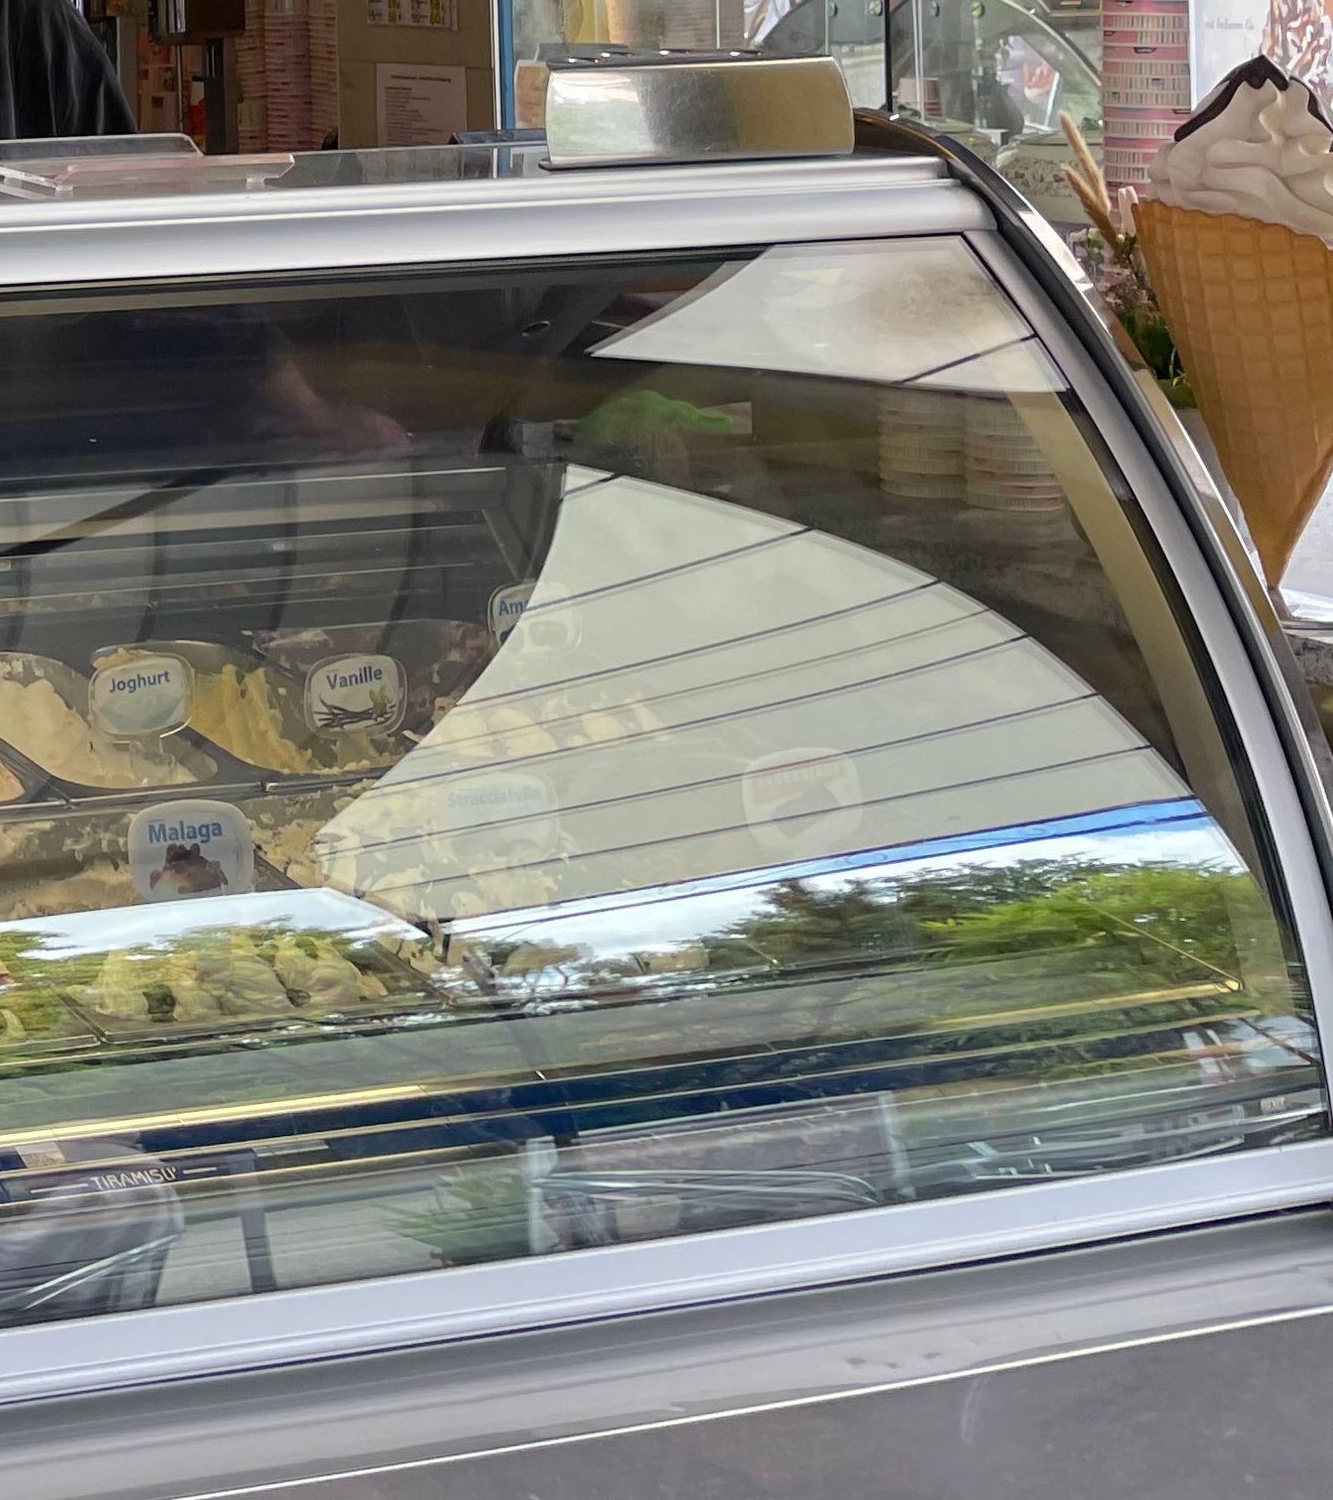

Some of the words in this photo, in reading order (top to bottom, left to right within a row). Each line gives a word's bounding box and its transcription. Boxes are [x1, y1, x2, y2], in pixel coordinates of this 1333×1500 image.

[108, 668, 171, 695] Joghurt
[325, 664, 383, 692] Vanille
[147, 818, 223, 848] Malaga
